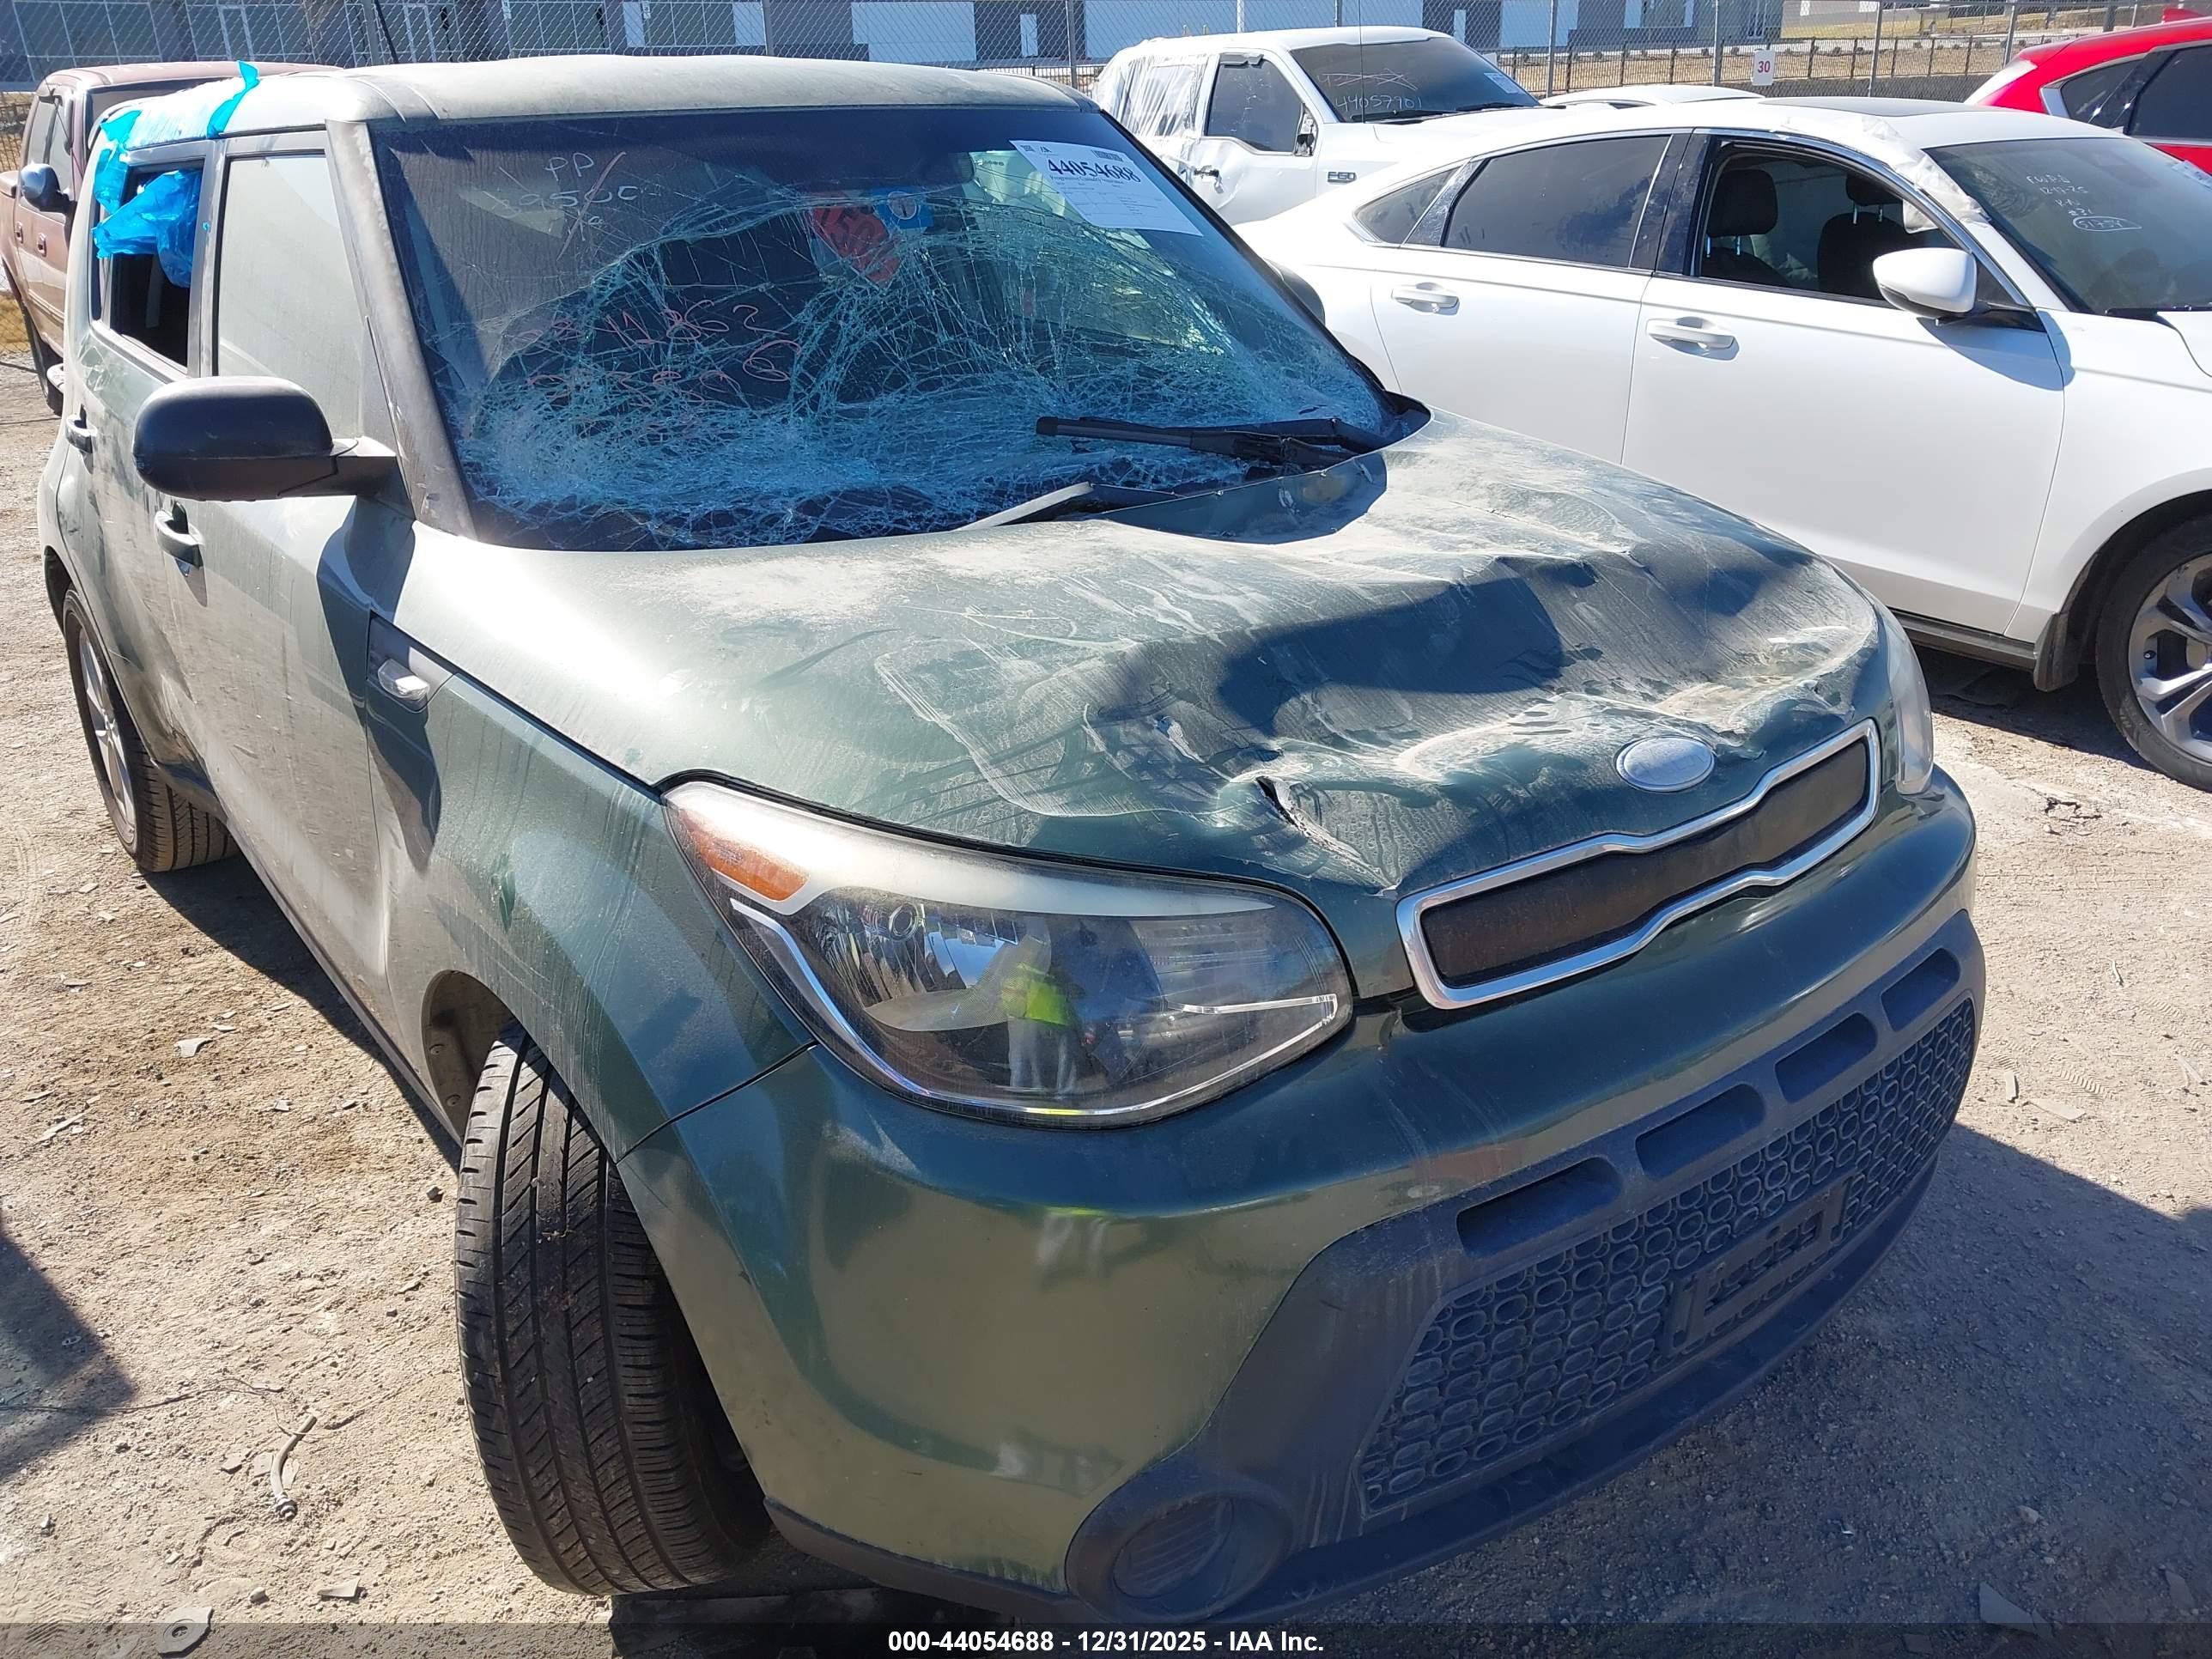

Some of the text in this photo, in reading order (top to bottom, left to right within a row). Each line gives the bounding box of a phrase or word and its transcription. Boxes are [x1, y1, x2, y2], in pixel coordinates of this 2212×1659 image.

[1758, 60, 1771, 73] 30
[544, 152, 594, 181] PP
[1048, 159, 1141, 183] 44054688
